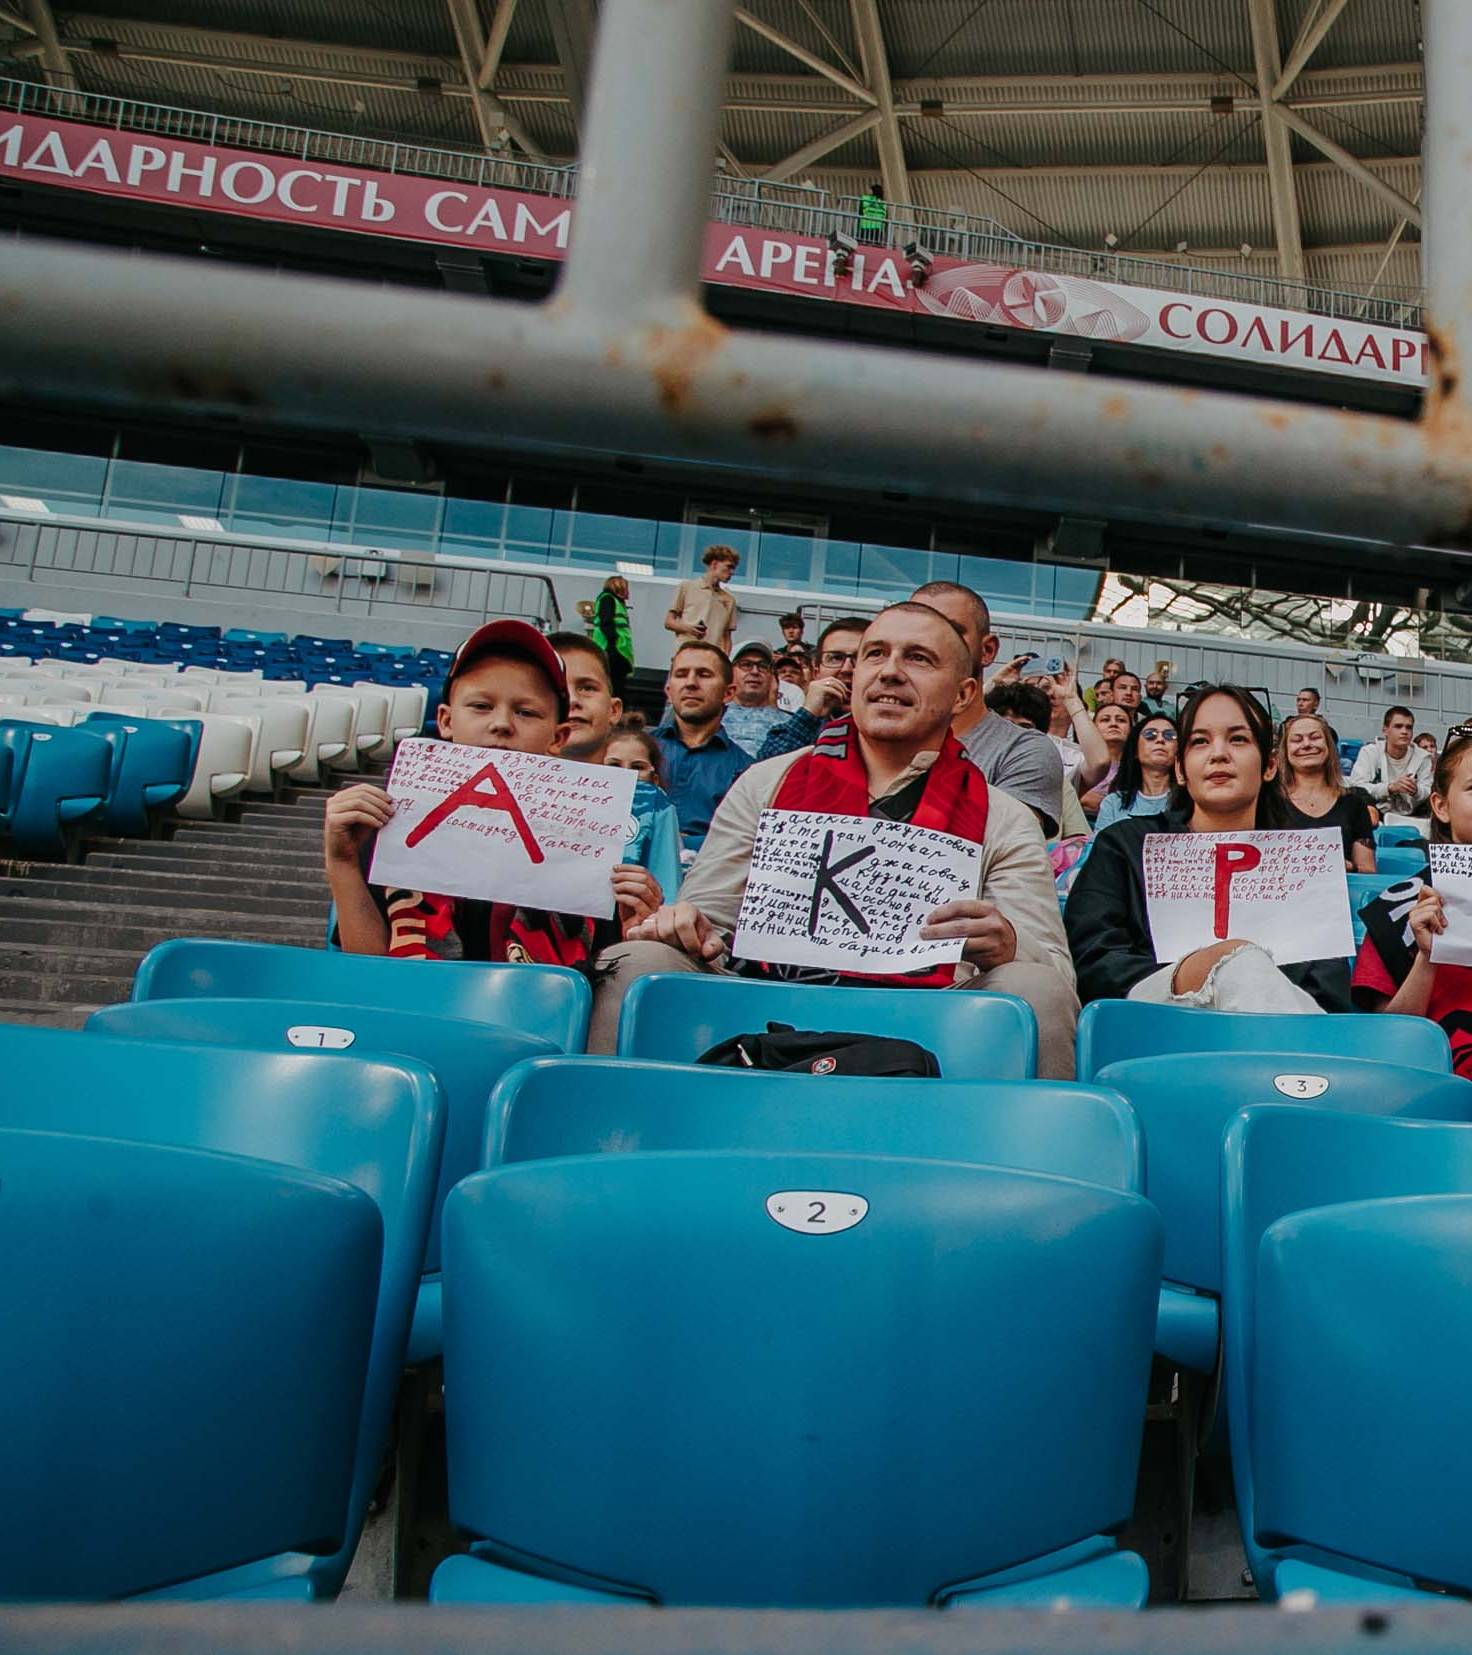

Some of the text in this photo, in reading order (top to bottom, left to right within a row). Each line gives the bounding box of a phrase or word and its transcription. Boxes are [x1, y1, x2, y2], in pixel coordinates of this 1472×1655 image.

[424, 191, 572, 249] САМ
[405, 762, 545, 864] А
[808, 830, 876, 936] К
[1214, 843, 1262, 940] Р
[318, 1032, 325, 1046] 1
[1297, 1081, 1307, 1092] 3
[807, 1202, 826, 1223] 2
